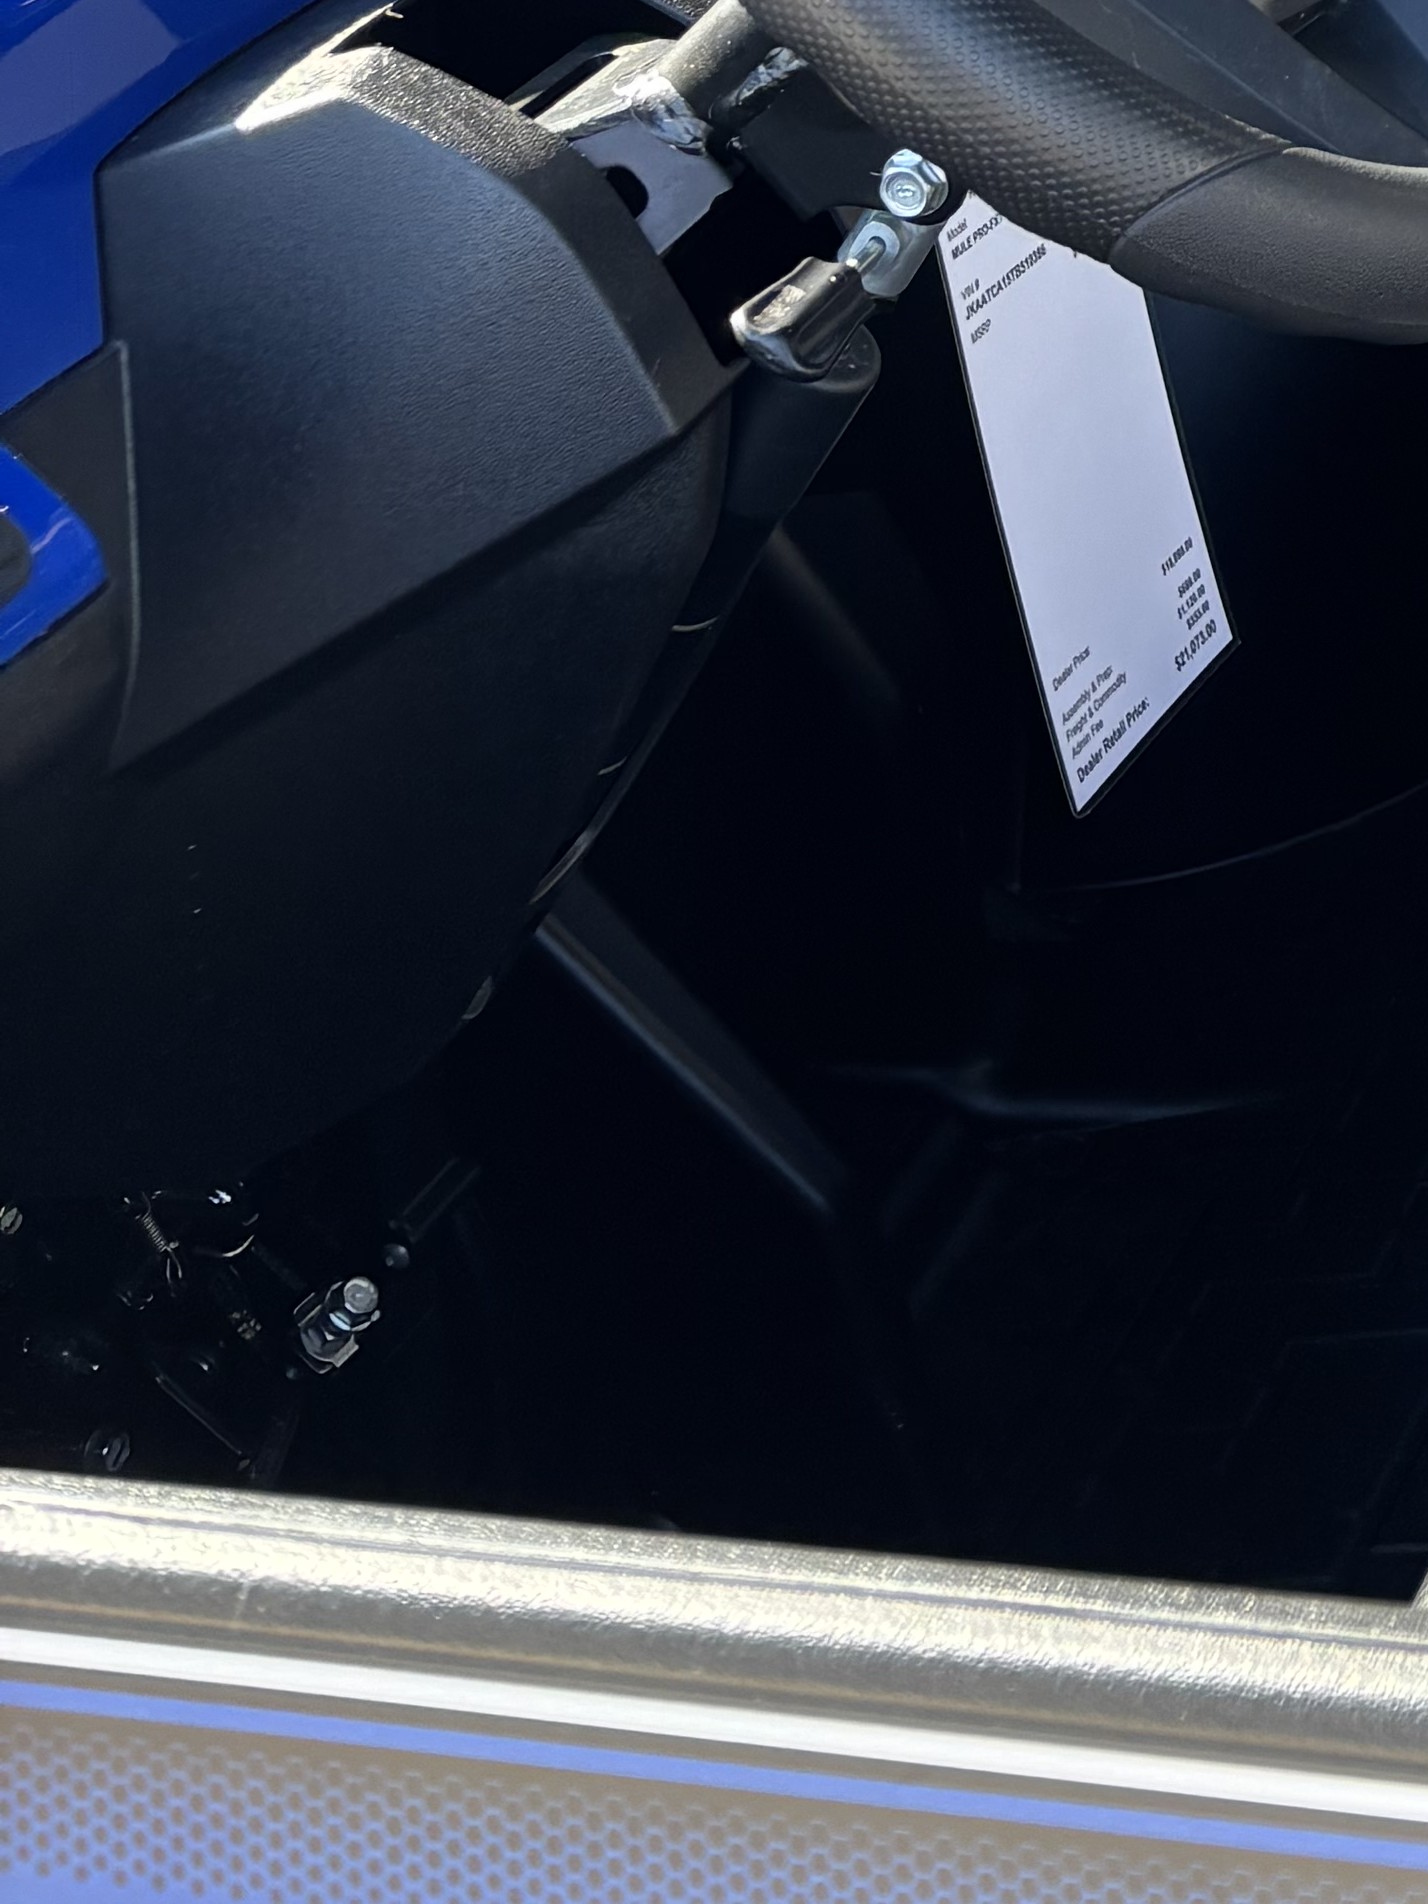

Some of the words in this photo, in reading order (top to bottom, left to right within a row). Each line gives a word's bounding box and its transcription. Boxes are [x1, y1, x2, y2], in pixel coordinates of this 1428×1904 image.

[951, 239, 974, 260] MULE
[1174, 618, 1217, 673] $21,073.00
[1052, 666, 1074, 692] Dealer
[1062, 686, 1092, 726] Assembly
[1065, 714, 1088, 743] Freight
[1087, 708, 1094, 720] &
[1093, 672, 1127, 712] Commodity
[1072, 734, 1091, 760] Admin
[1076, 747, 1104, 784] Dealer
[1102, 721, 1127, 754] Retail
[1125, 696, 1150, 729] Price:
